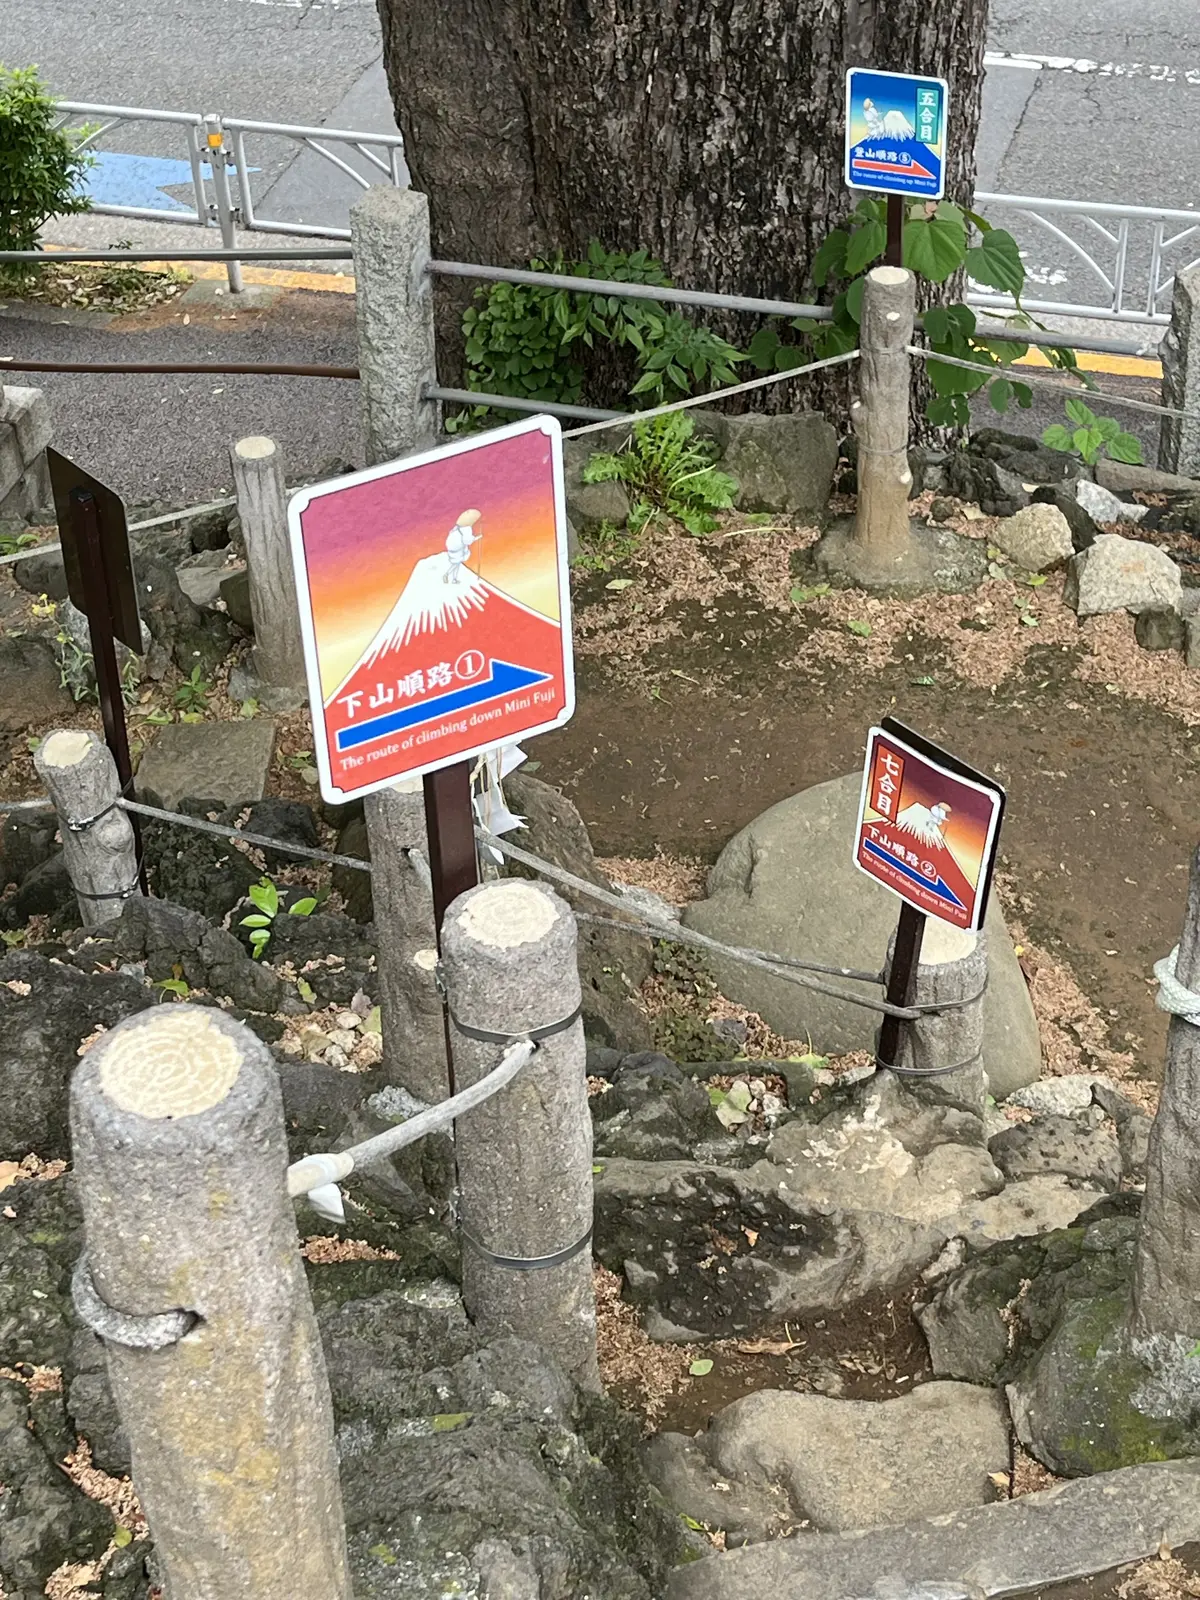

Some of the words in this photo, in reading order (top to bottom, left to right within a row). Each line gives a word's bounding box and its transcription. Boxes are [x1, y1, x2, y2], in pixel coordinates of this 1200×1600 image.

[919, 92, 936, 141] 五合目
[340, 756, 364, 771] The
[366, 743, 400, 763] route
[401, 735, 415, 750] of
[416, 720, 468, 745] climbing
[469, 708, 502, 726] down
[504, 696, 530, 714] Mini
[533, 687, 555, 704] Fuji
[877, 754, 900, 815] 七合目
[862, 850, 873, 862] The
